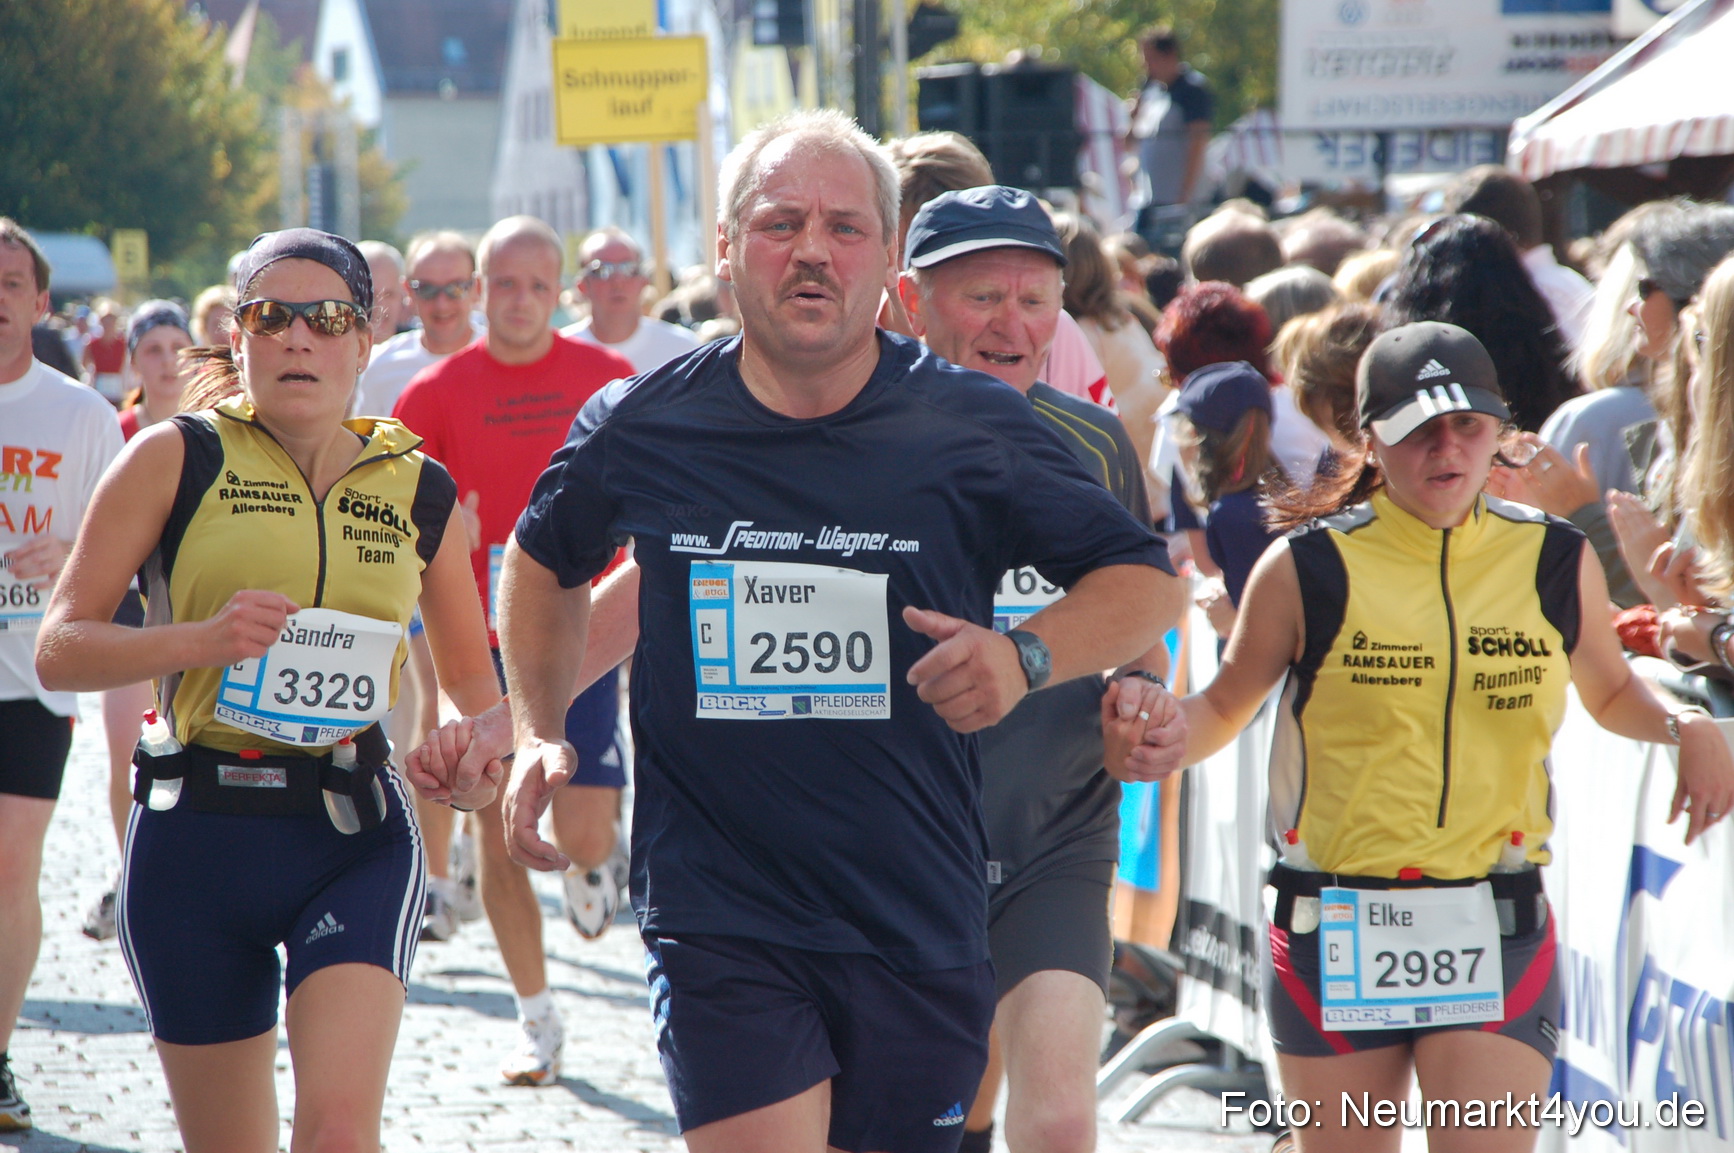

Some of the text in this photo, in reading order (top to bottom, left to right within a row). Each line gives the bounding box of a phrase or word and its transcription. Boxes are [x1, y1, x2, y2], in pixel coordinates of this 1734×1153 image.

[1417, 368, 1451, 381] adidas
[3, 446, 62, 480] RZ
[243, 480, 289, 489] Zimmerei
[219, 488, 303, 504] RAMSAUER
[232, 504, 295, 516] Allersberg
[338, 496, 411, 537] SCHÖLL
[343, 525, 403, 548] Running-
[357, 546, 395, 564] Team
[744, 575, 816, 604] Xaver
[281, 619, 355, 649] Sandra
[701, 623, 712, 645] C
[750, 631, 873, 674] 2590
[1371, 642, 1423, 652] Zimmerei
[1468, 631, 1552, 657] SCHÖLL
[1343, 654, 1435, 669] RAMSAUER
[1352, 673, 1422, 687] Allersberg
[1473, 665, 1547, 691] Running-
[274, 668, 375, 711] 3329
[700, 695, 767, 711] BOCK
[814, 696, 886, 708] PFLEIDERER
[1487, 693, 1533, 710] Team
[217, 707, 282, 732] BOCK
[814, 709, 886, 717] AKTIENGESELLSCHAFT
[224, 772, 281, 782] PERFEKTA
[1369, 902, 1413, 927] Elke
[306, 923, 345, 944] adidas
[1329, 943, 1339, 962] C
[1375, 947, 1486, 988] 2987
[1325, 1008, 1392, 1023] BOCK
[1435, 1001, 1499, 1016] PFLEIDERER
[933, 1114, 965, 1127] adidas
